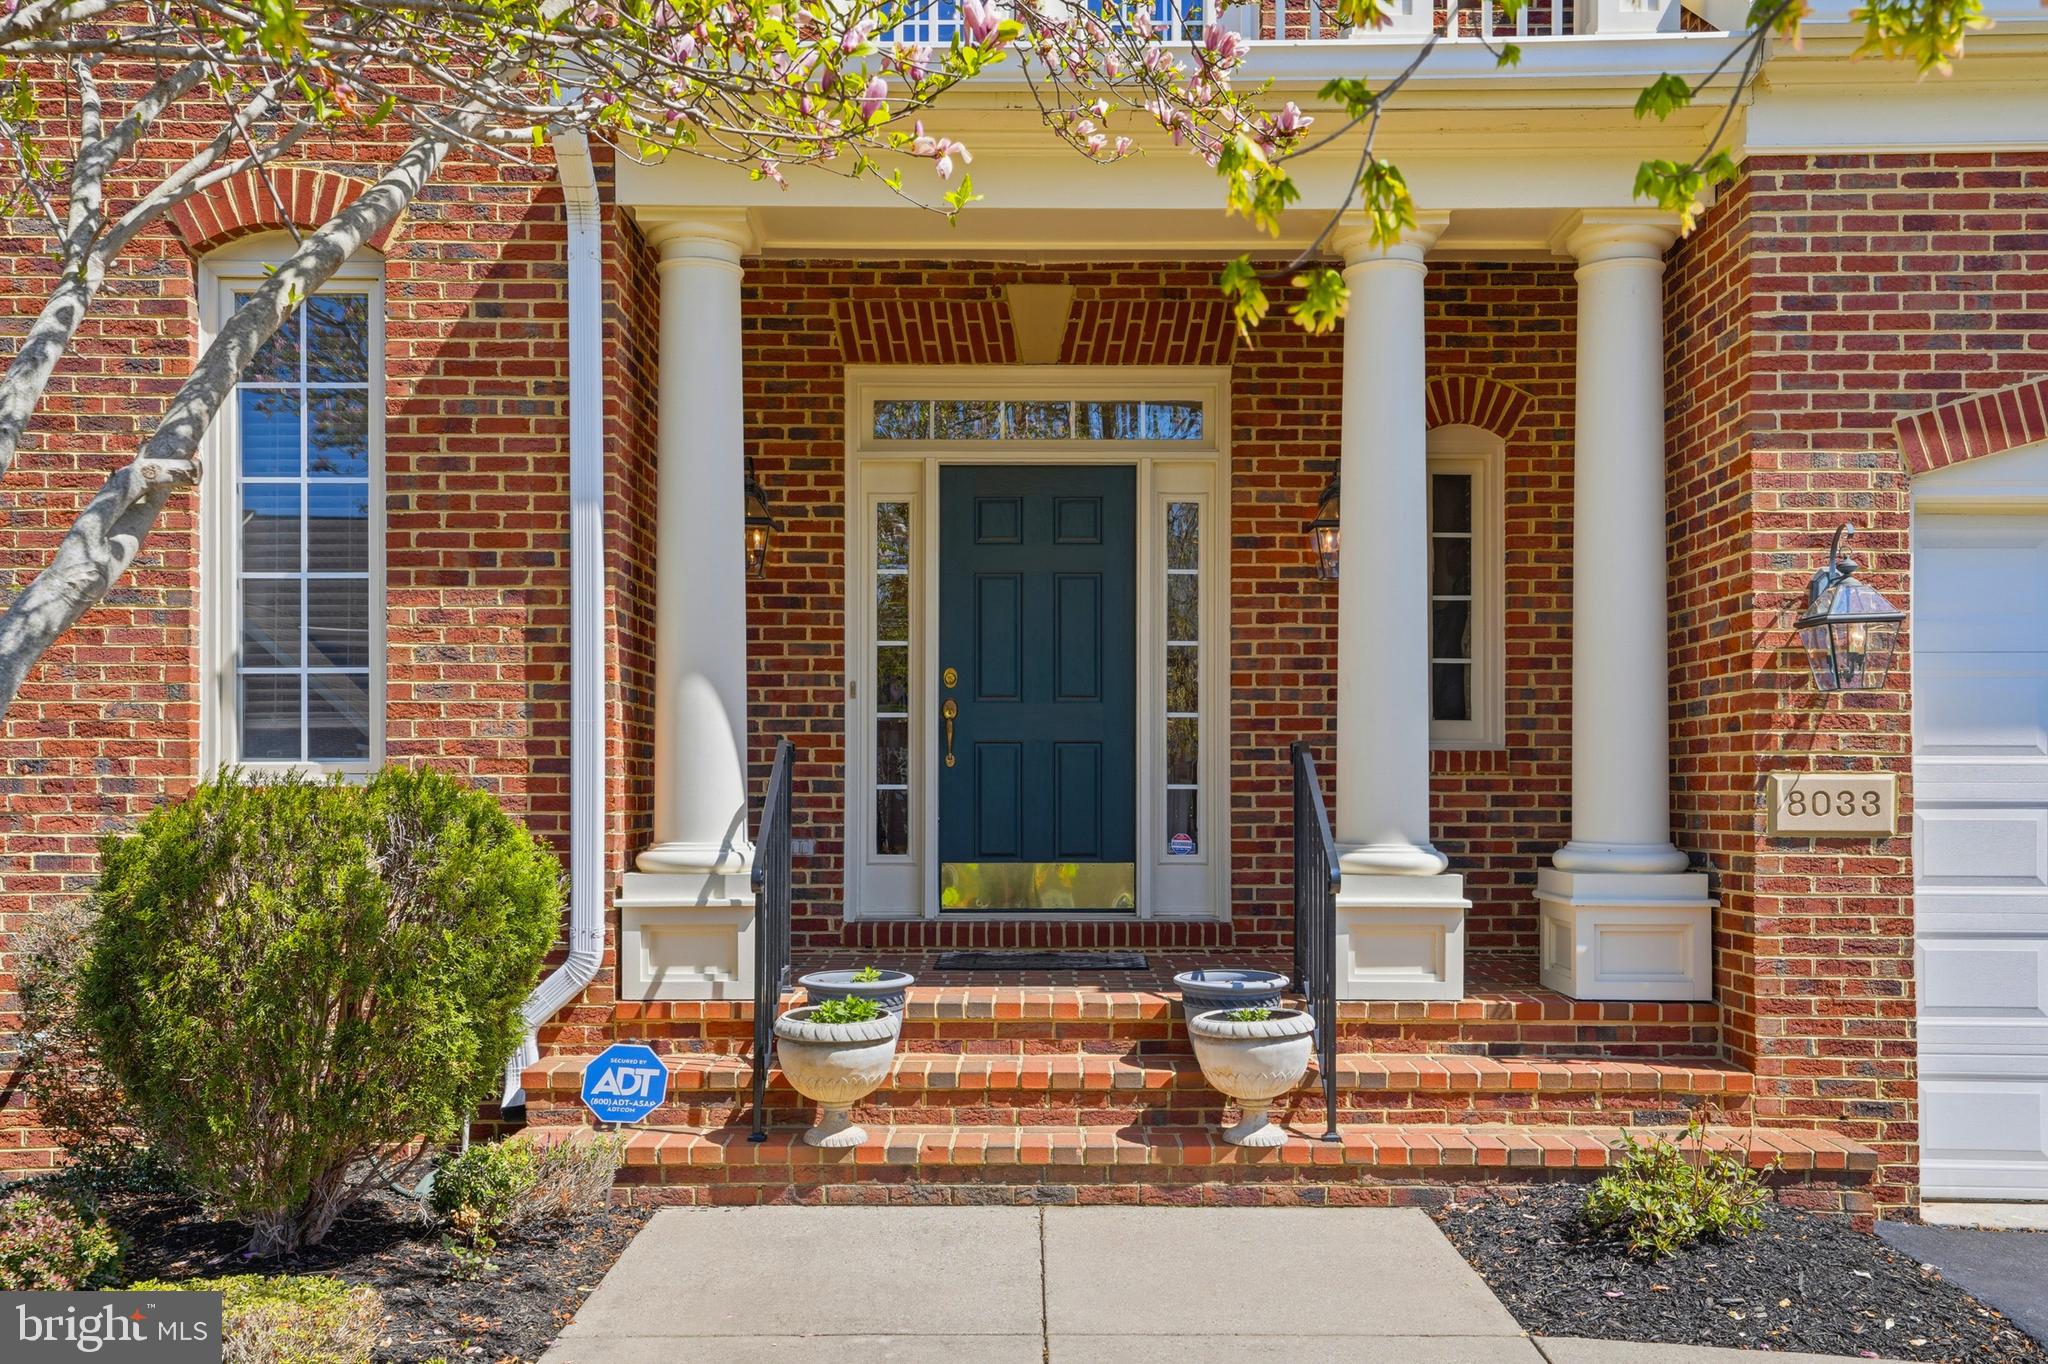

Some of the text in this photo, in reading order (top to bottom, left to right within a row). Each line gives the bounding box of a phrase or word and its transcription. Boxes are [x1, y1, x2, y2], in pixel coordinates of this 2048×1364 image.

[1787, 790, 1881, 817] 8033
[610, 1057, 638, 1065] SECURED
[590, 1066, 661, 1097] ADT
